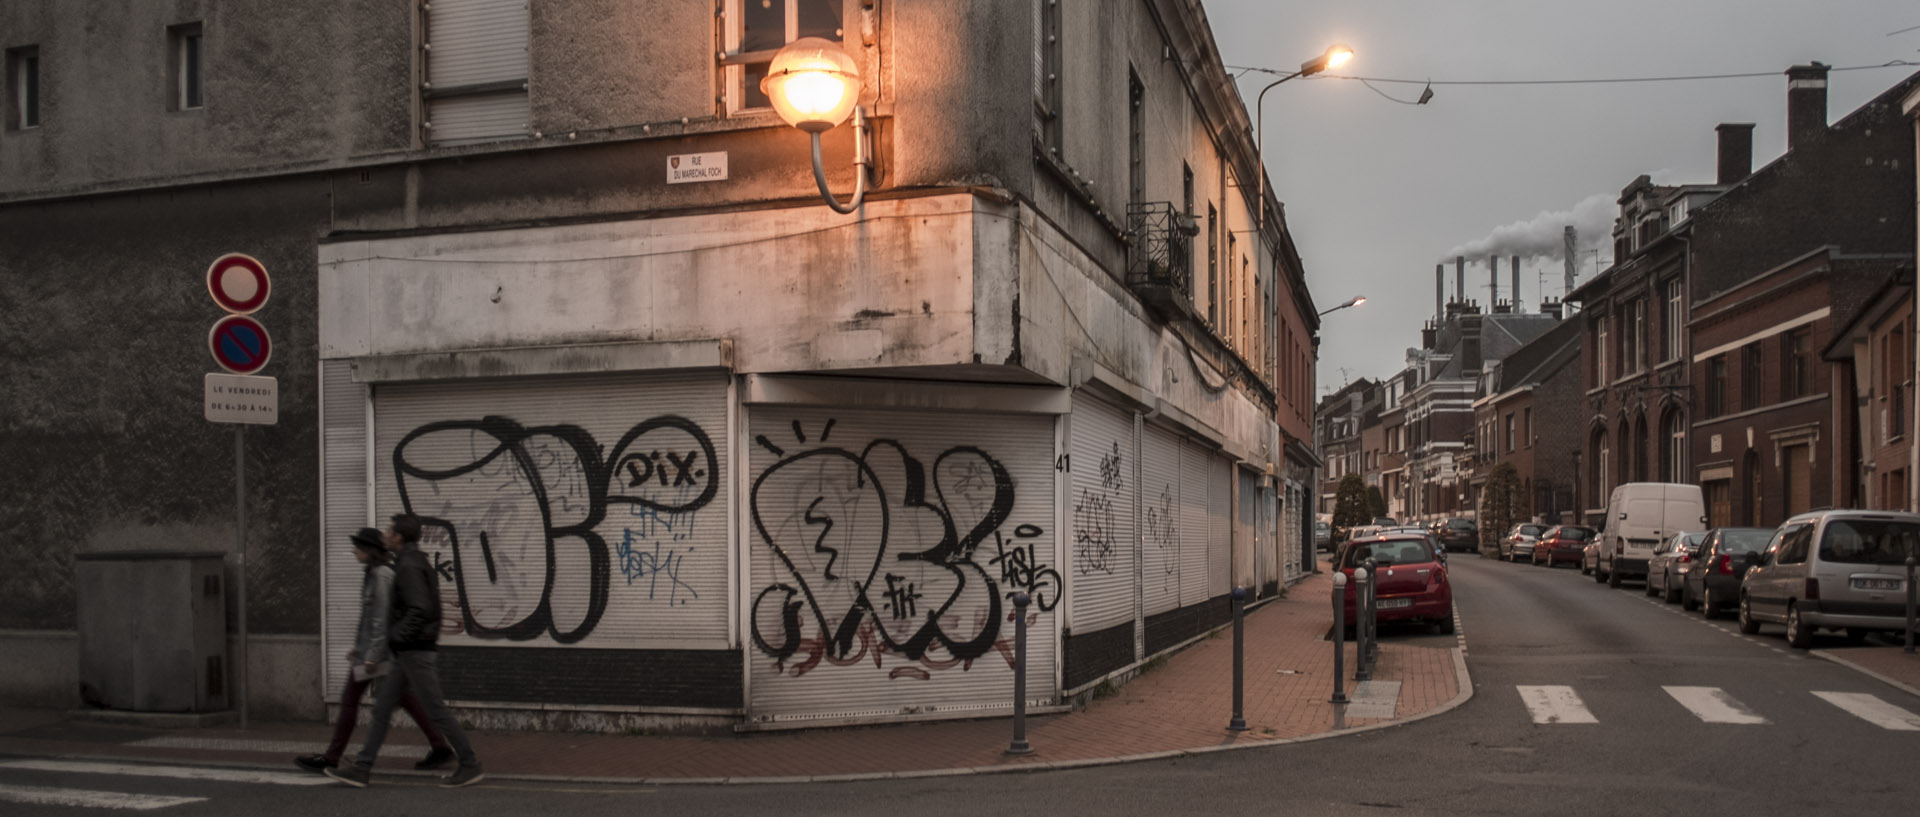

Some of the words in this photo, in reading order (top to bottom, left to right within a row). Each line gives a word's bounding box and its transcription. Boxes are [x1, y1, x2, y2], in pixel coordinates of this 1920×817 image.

[691, 156, 702, 166] RUE
[674, 170, 681, 180] DU
[682, 168, 707, 179] MARECHAL
[708, 167, 722, 177] FOCH
[228, 387, 271, 396] VENDREDI
[1056, 453, 1070, 473] 41
